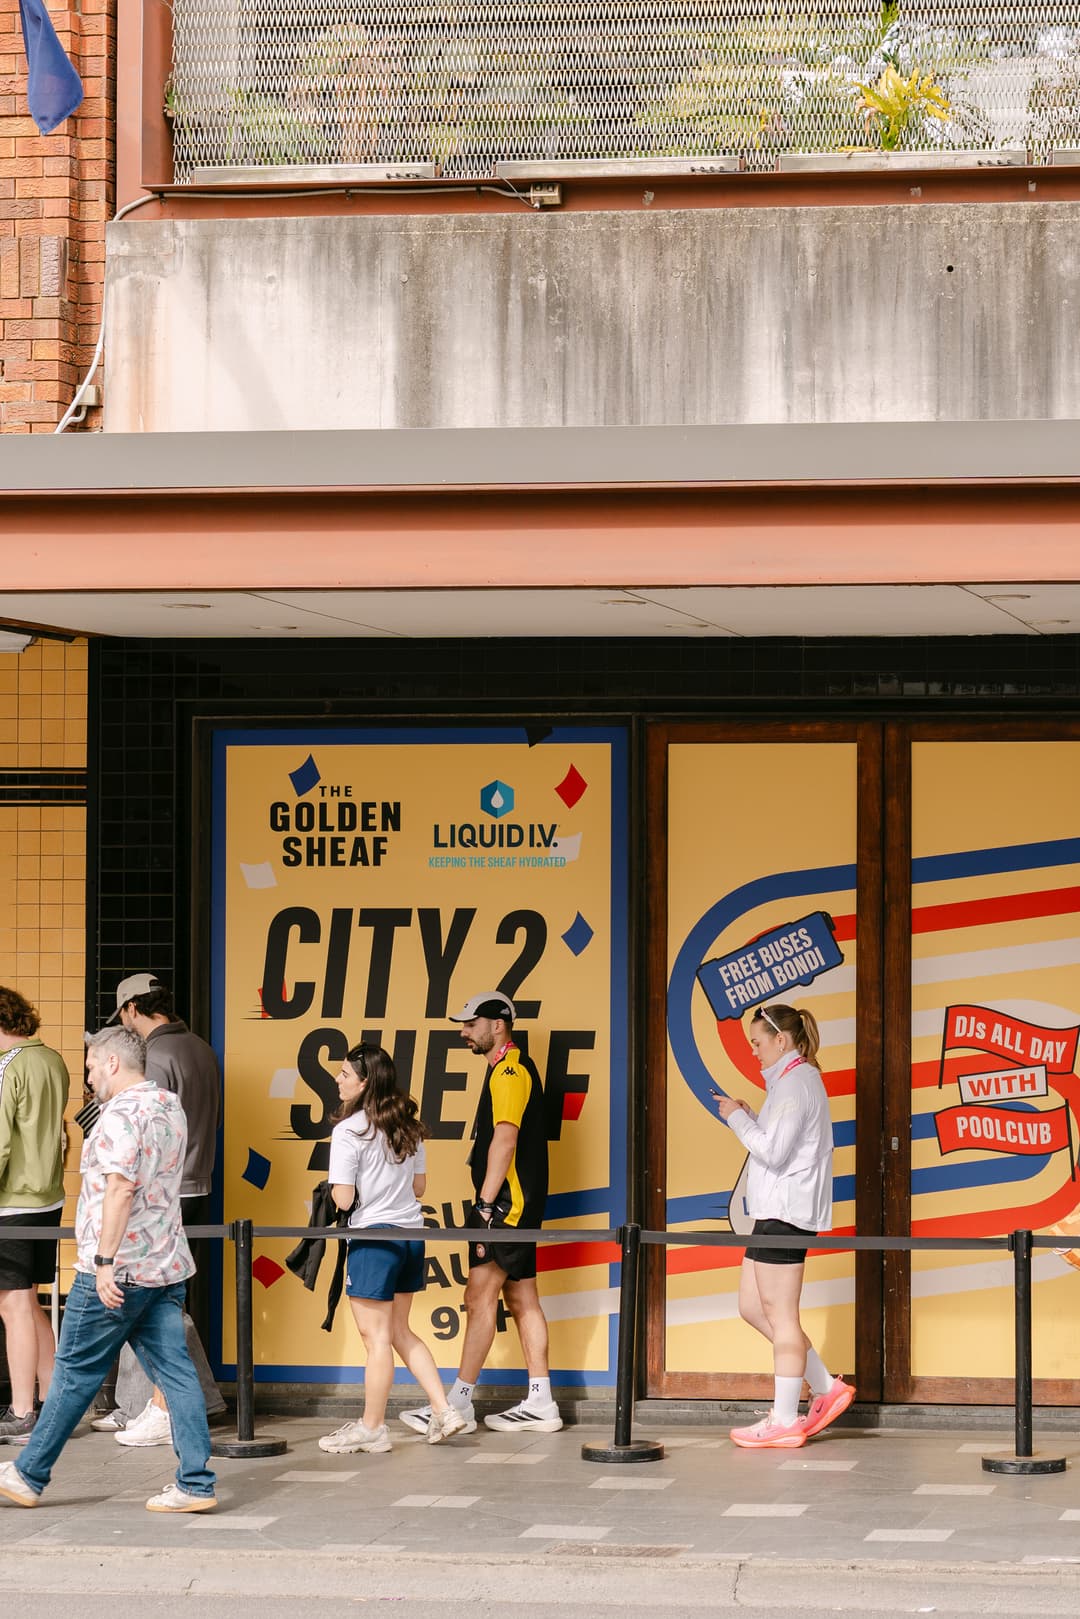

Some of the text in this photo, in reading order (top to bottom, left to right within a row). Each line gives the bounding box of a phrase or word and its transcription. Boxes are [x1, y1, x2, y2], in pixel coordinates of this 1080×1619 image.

[319, 785, 353, 798] THE
[270, 801, 401, 832] GOLDEN
[282, 836, 388, 867] SHEAF
[433, 823, 525, 849] LIQUID
[428, 856, 567, 869] KEEPING THE SHEAF HYDRATED
[261, 906, 548, 1020] CITY 2
[718, 927, 813, 987] FREE BUSES
[725, 946, 826, 1009] FROM BONDI
[954, 1015, 1068, 1064] DJs ALL DAY
[290, 1027, 596, 1141] SEF
[967, 1072, 1037, 1097] WITH
[956, 1115, 1052, 1145] POOLCLVB
[420, 1199, 475, 1229] SU
[422, 1253, 469, 1292] AU
